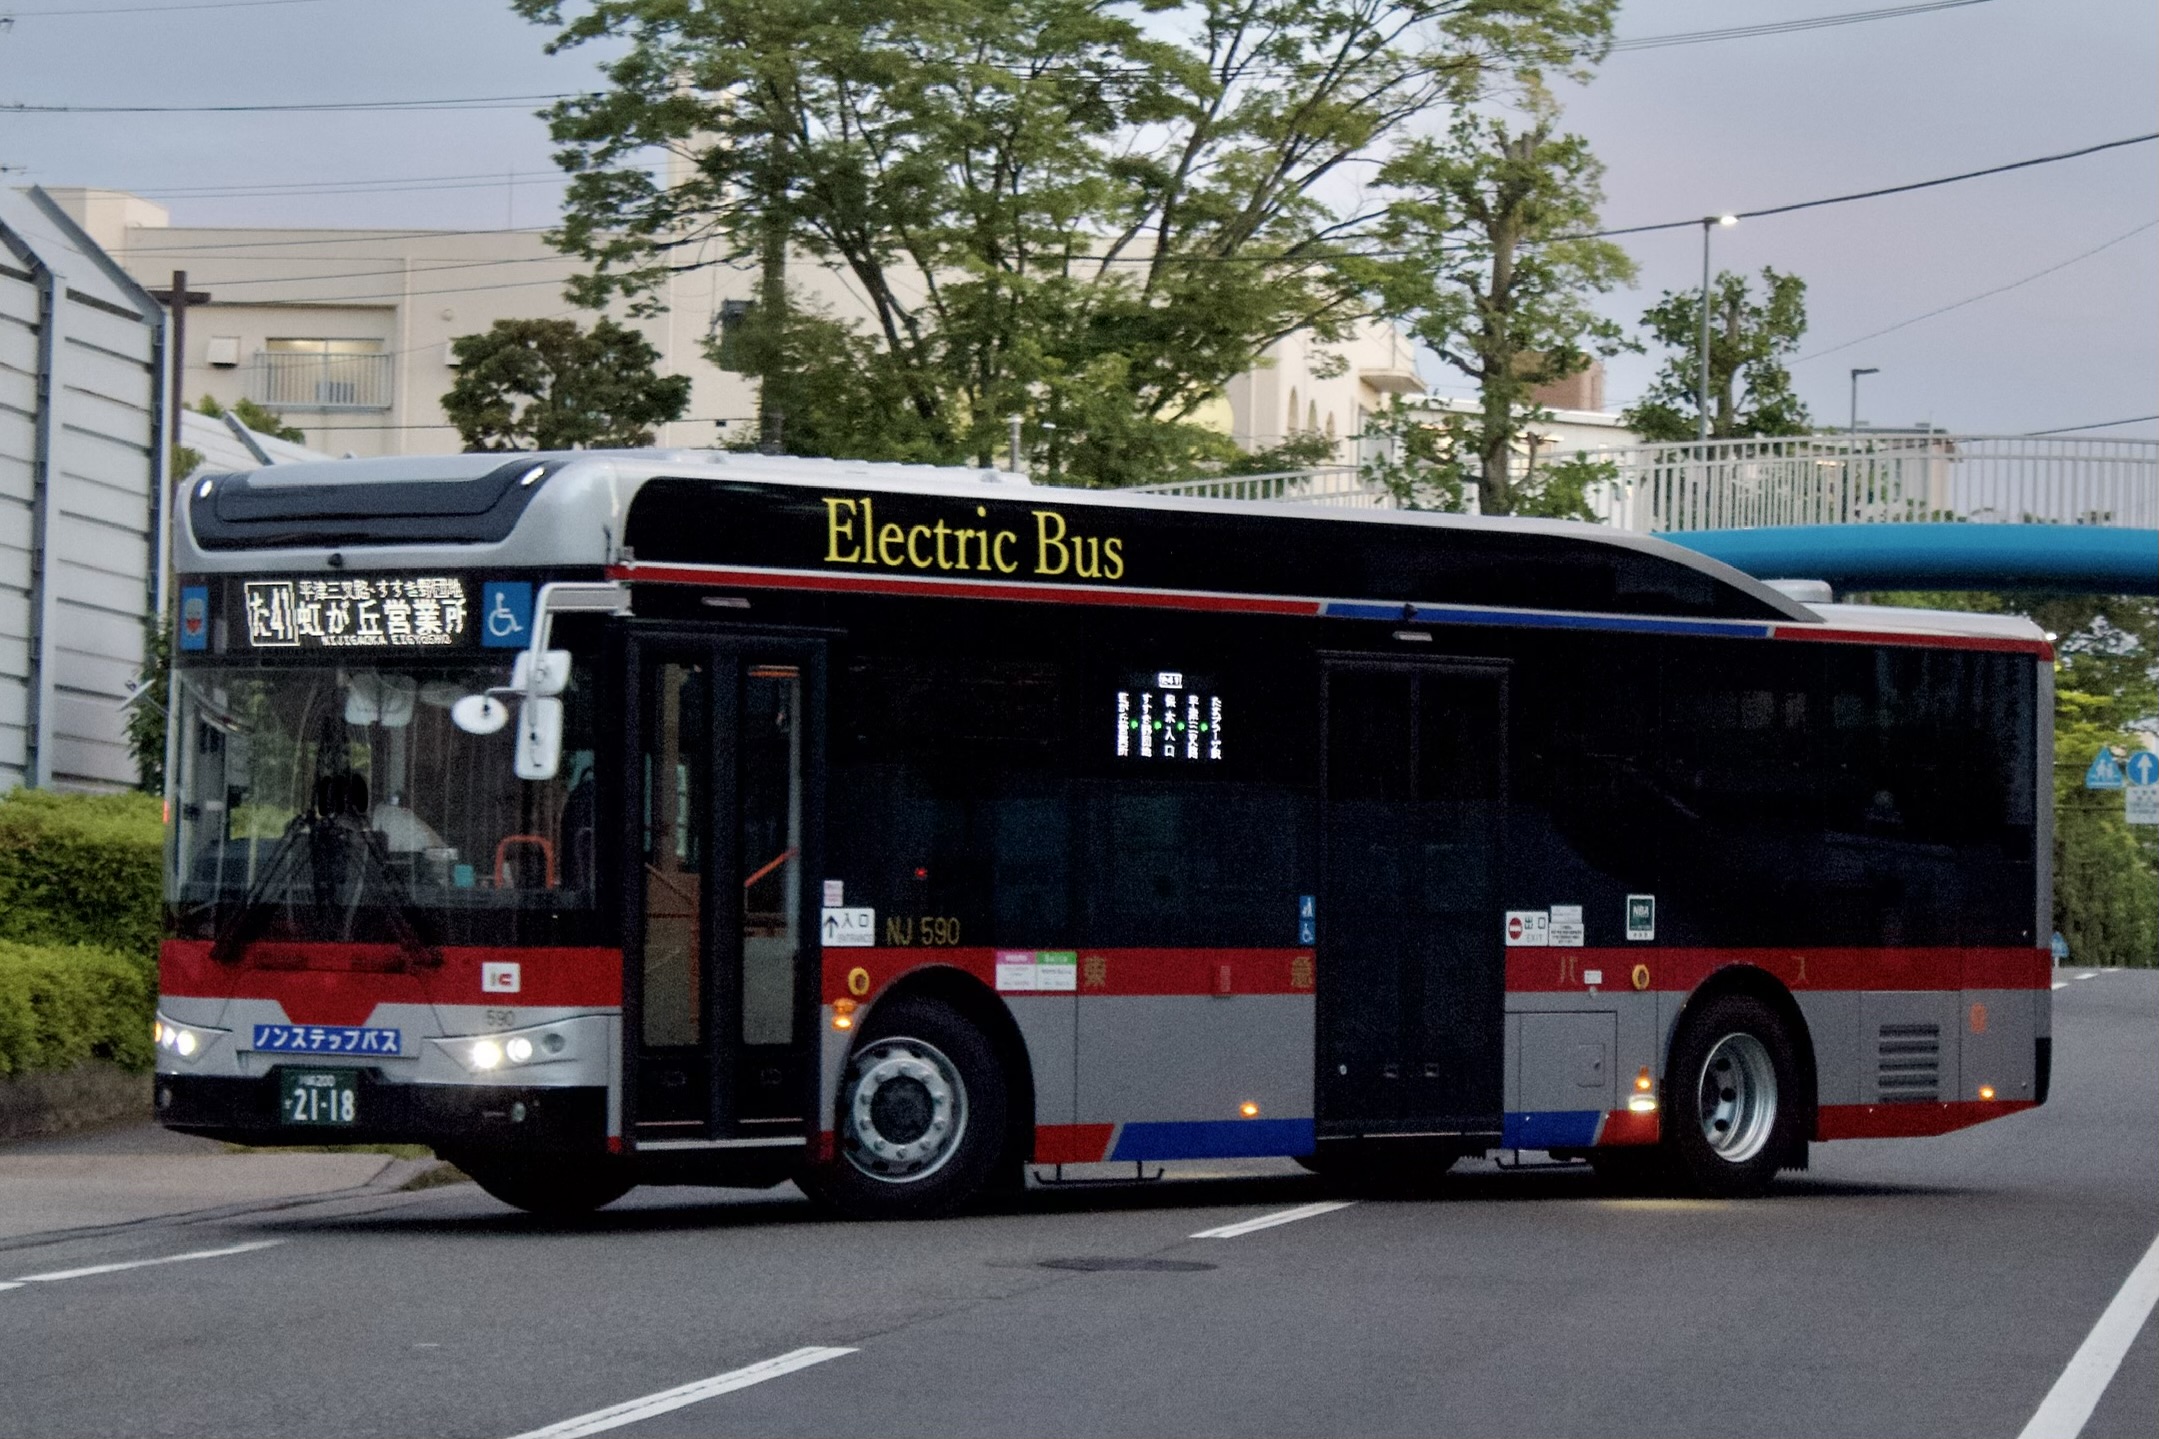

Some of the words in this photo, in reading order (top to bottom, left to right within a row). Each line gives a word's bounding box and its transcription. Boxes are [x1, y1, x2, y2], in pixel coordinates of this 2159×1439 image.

[822, 497, 1018, 574] Electric
[1032, 510, 1124, 580] Bus
[297, 598, 468, 636] 虹が丘営業所
[841, 912, 869, 929] 入口
[886, 916, 913, 945] NJ
[920, 916, 961, 945] 590
[487, 1009, 516, 1027] 590
[255, 1027, 399, 1053] ノンステップバス
